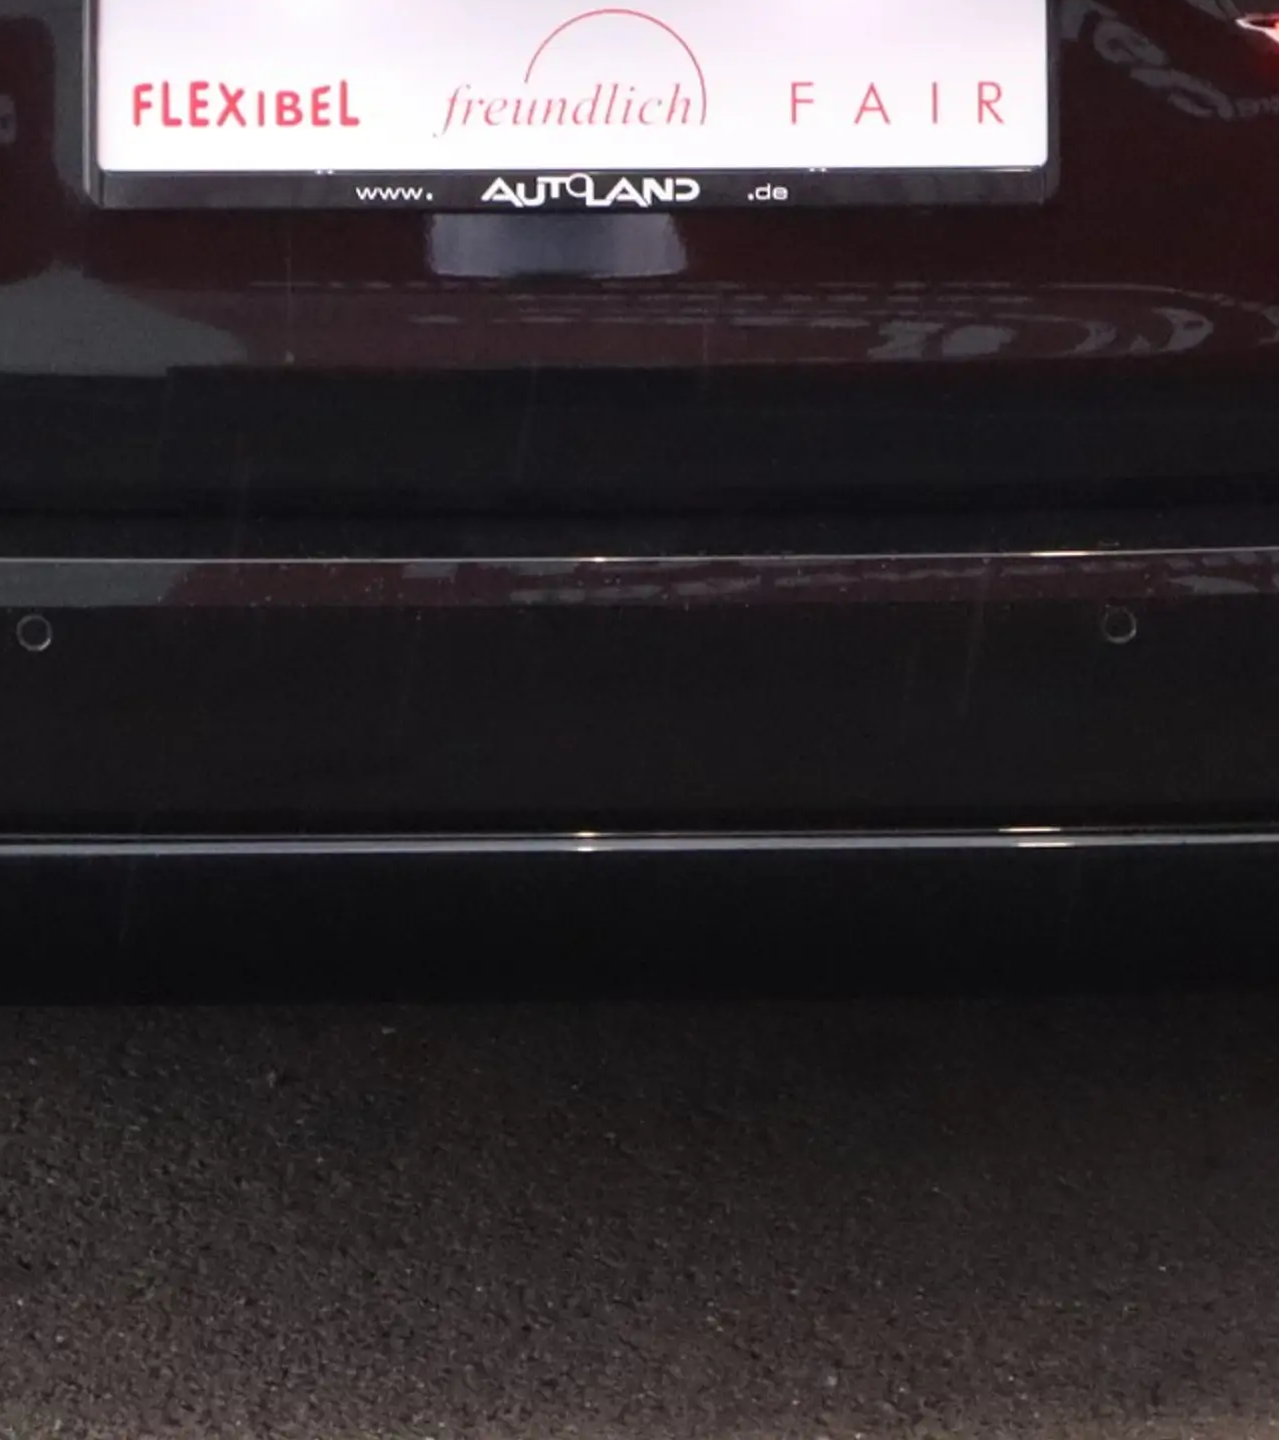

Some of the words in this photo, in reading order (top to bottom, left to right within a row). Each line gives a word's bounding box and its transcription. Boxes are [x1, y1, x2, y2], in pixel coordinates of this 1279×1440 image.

[132, 79, 361, 128] FLEXIBEL
[432, 80, 693, 139] freundlich
[789, 80, 1005, 125] FAIR
[481, 172, 701, 209] AUTOLAND
